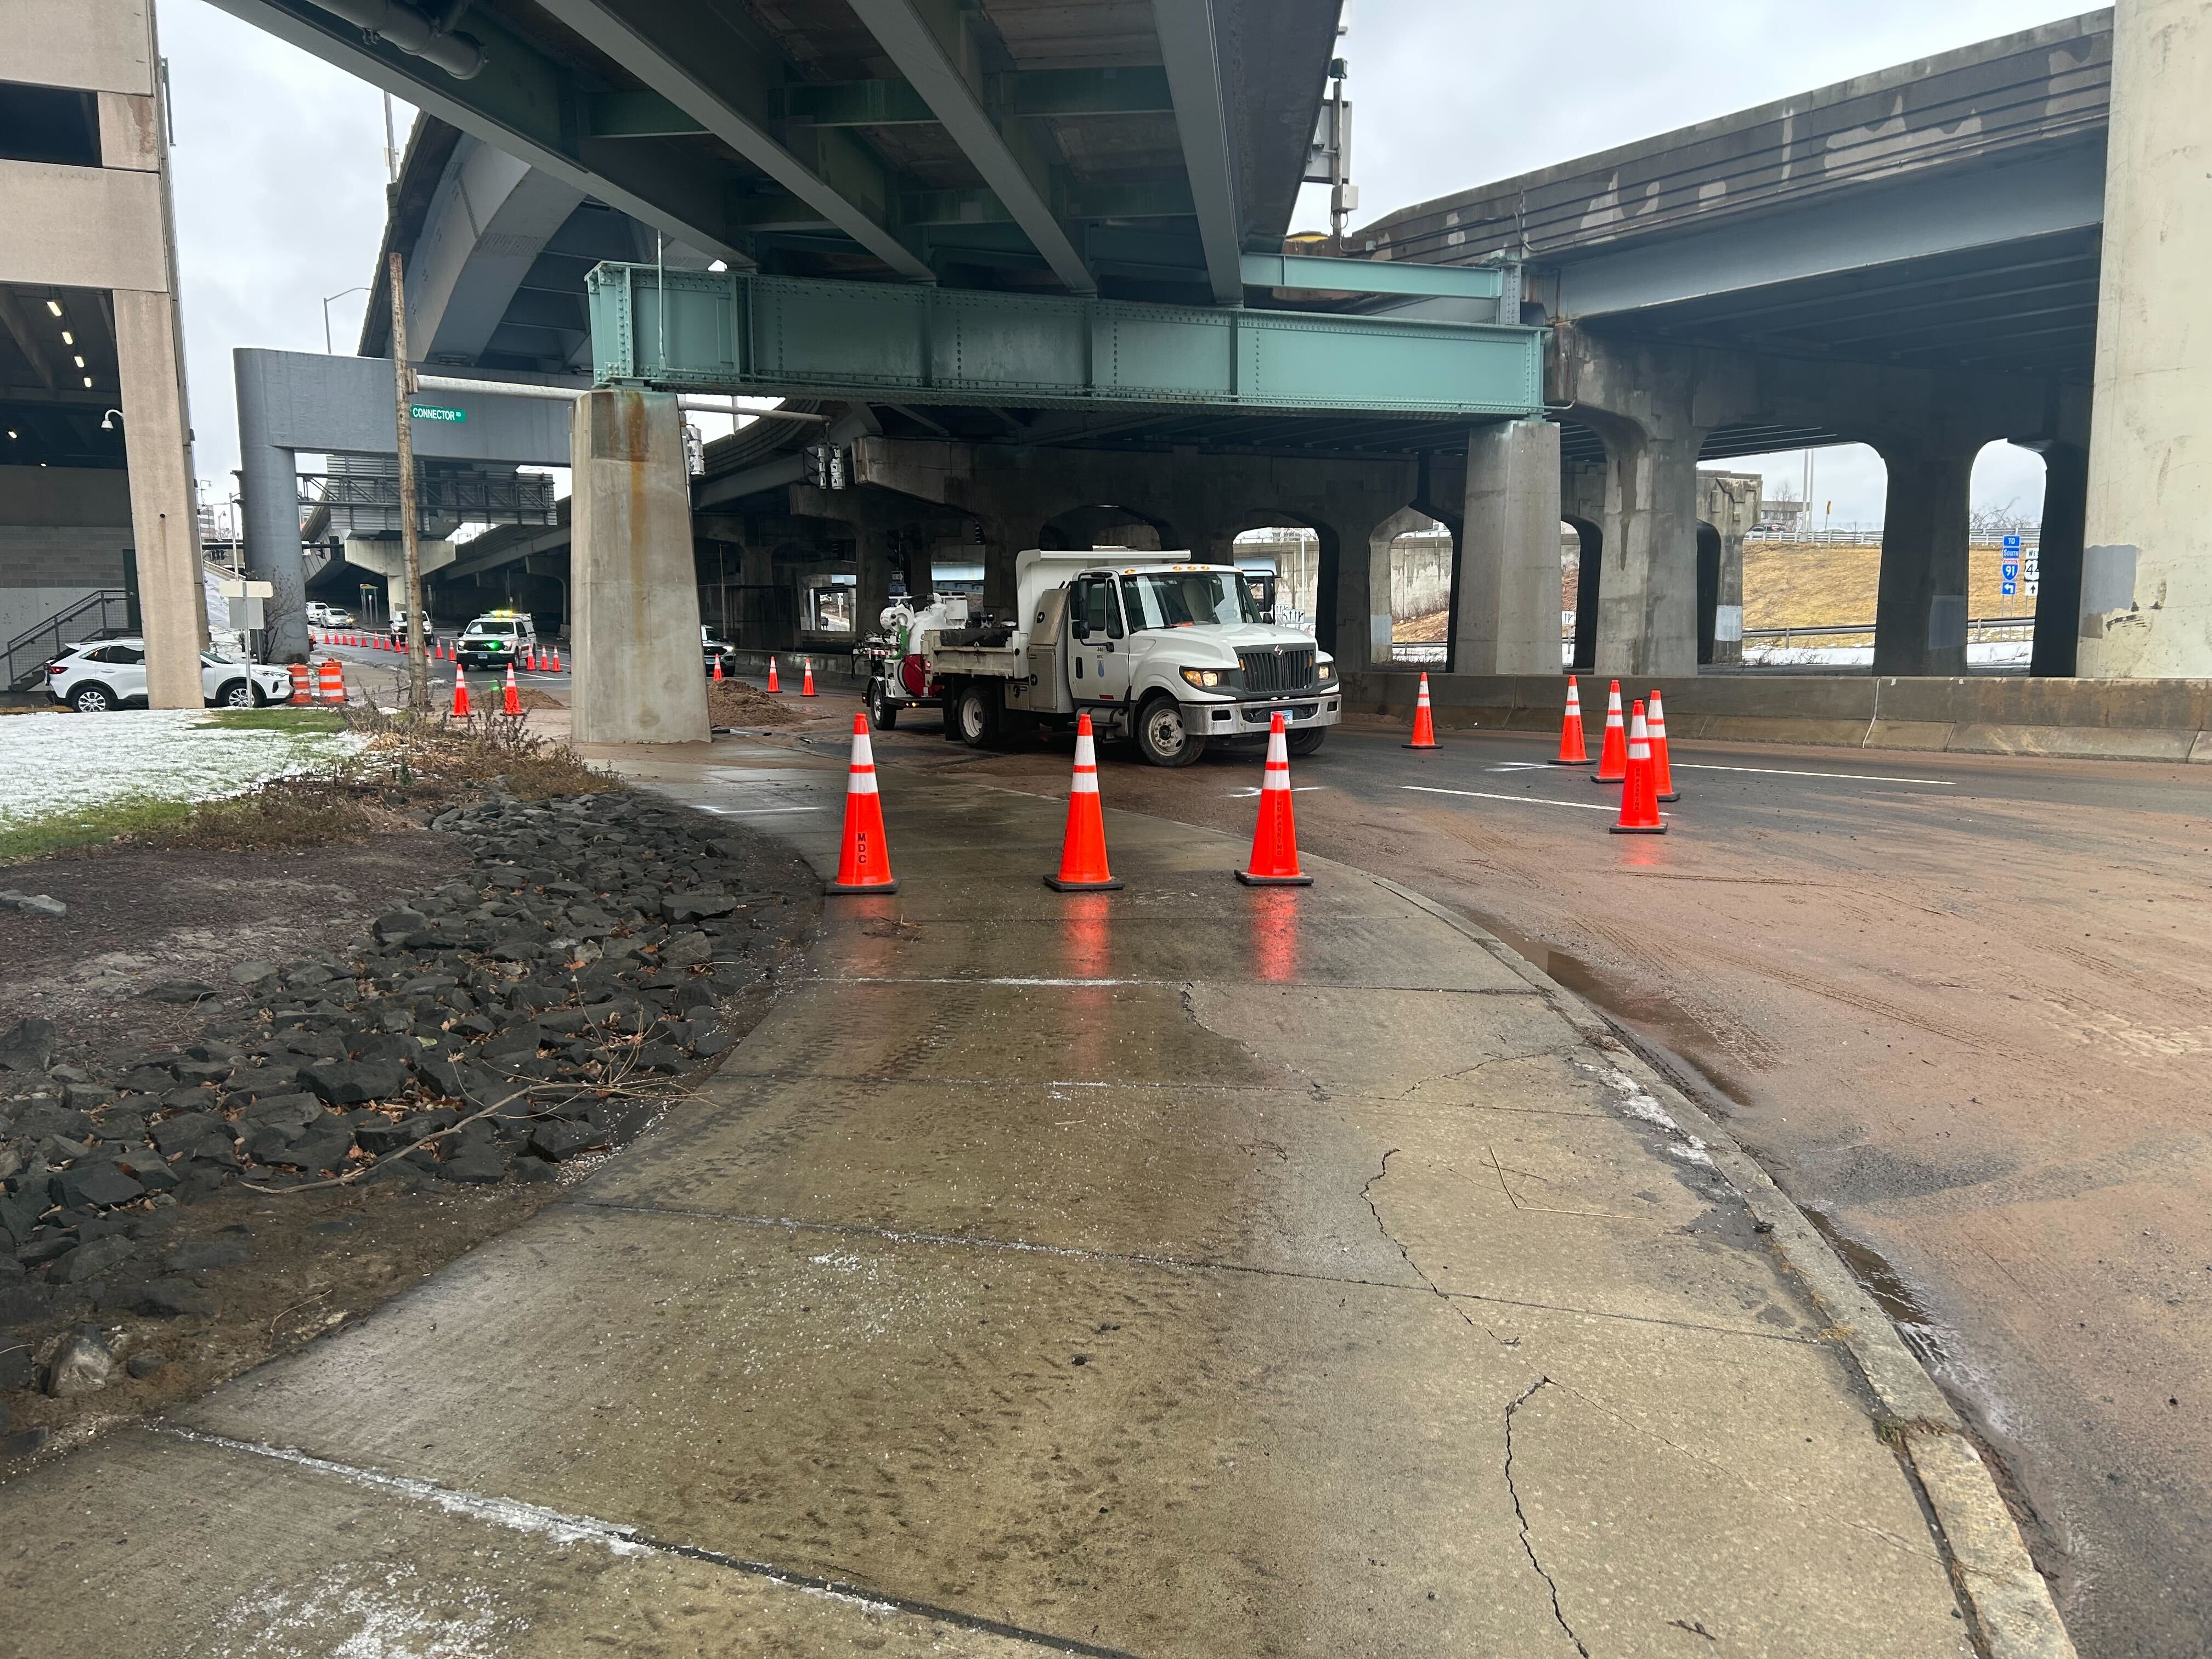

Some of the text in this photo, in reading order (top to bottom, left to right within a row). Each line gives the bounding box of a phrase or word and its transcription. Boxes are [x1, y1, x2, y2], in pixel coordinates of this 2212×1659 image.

[413, 408, 455, 420] CONNECTOR
[2004, 549, 2019, 557] SOUTH
[2005, 566, 2015, 576] 91
[1277, 799, 1282, 812] NO
[857, 832, 867, 864] MDC
